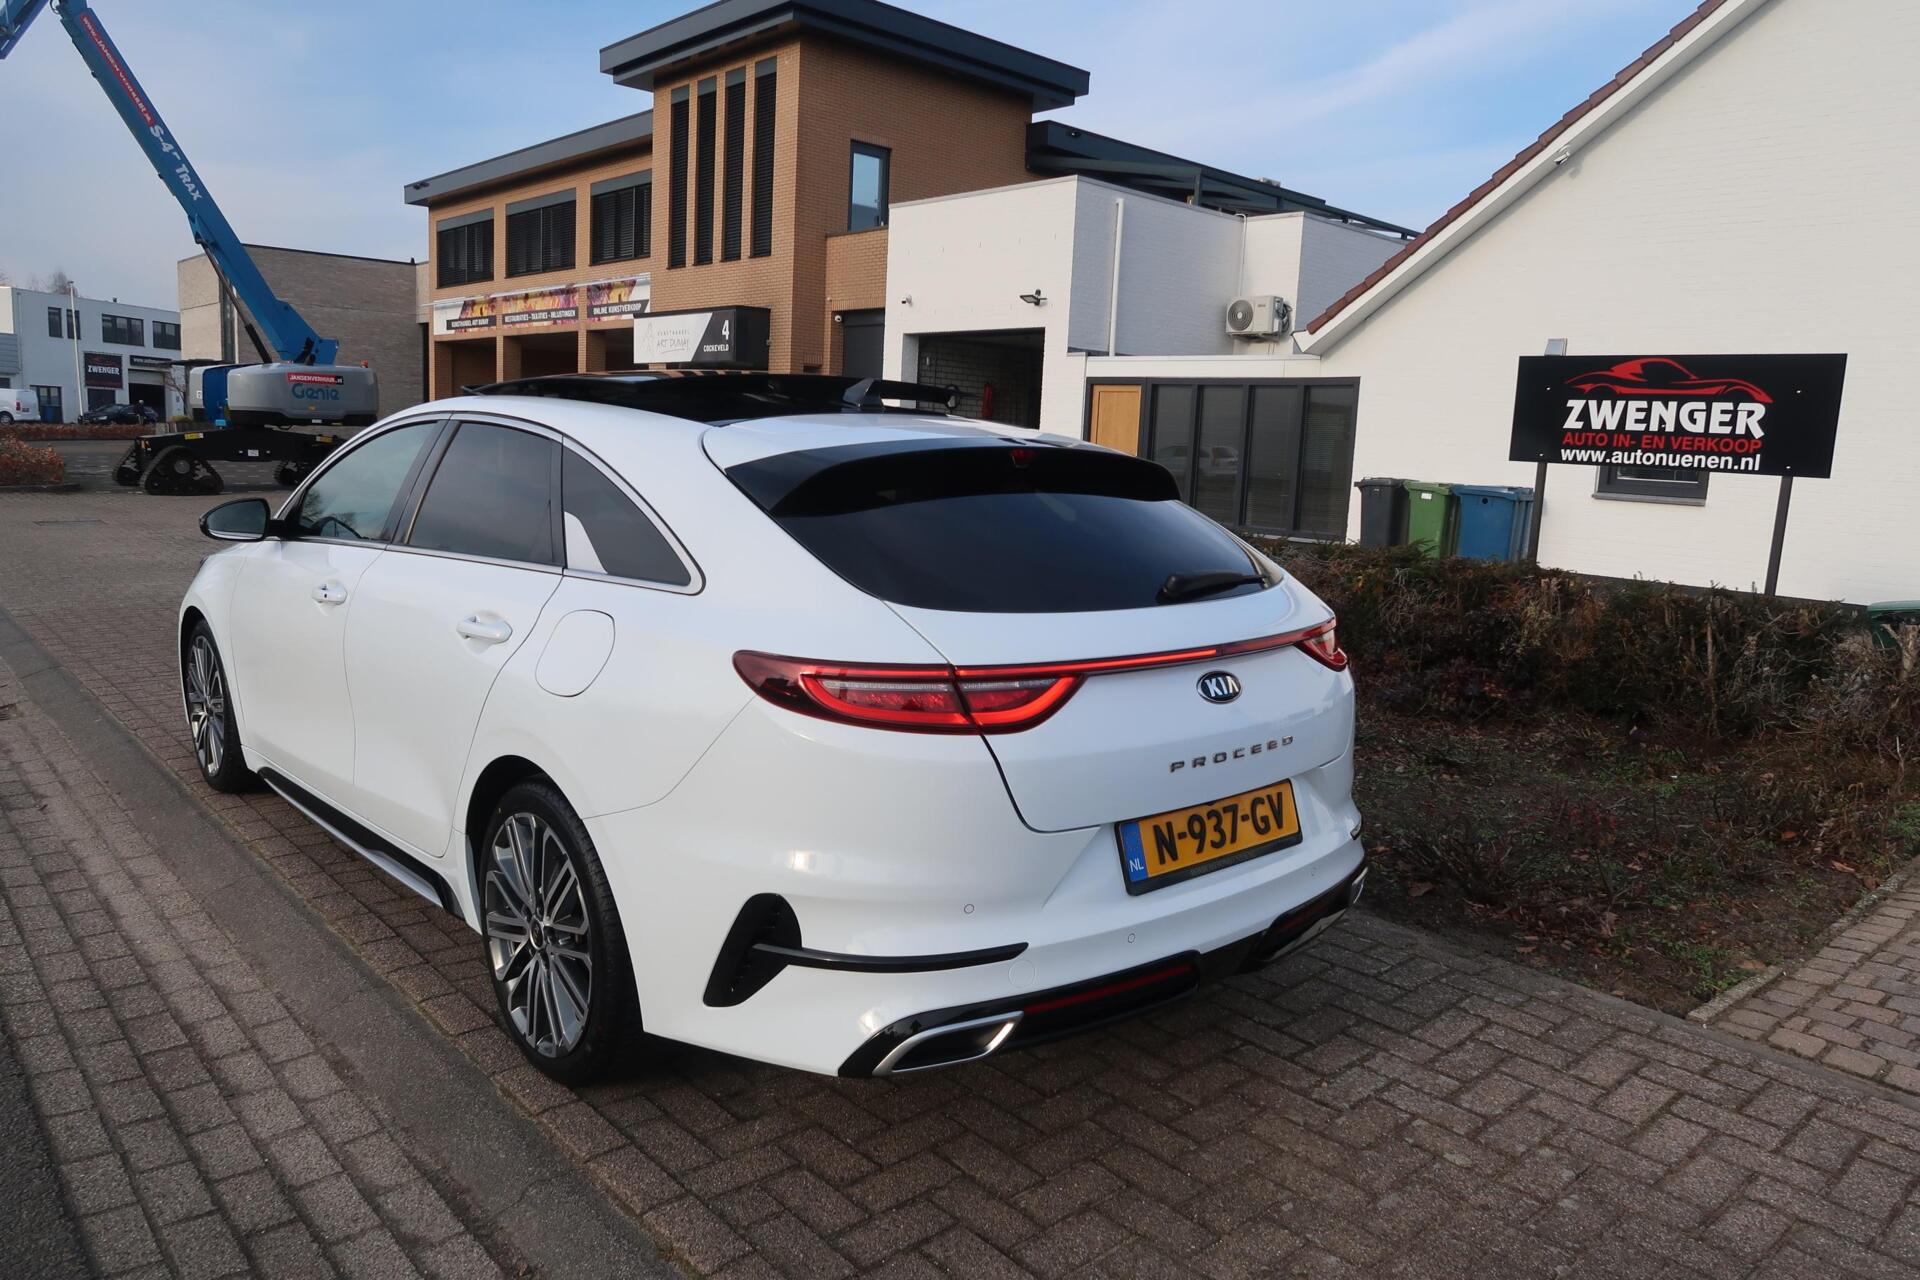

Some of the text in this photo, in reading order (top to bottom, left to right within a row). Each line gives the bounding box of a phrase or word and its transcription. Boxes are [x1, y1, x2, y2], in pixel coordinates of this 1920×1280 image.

[722, 319, 730, 340] 4
[703, 344, 729, 352] COCKEVELD
[88, 365, 120, 375] ZWENGER
[291, 383, 340, 400] Genie
[1562, 399, 1766, 440] ZWENGER
[1562, 431, 1763, 454] AUTO IN- EN VERKOOP
[1560, 448, 1762, 471] www.autonuenen.nl
[1205, 675, 1240, 697] KIA
[1169, 735, 1294, 772] PROCEED
[1129, 858, 1145, 872] NL
[1153, 791, 1284, 866] N-937-GV
